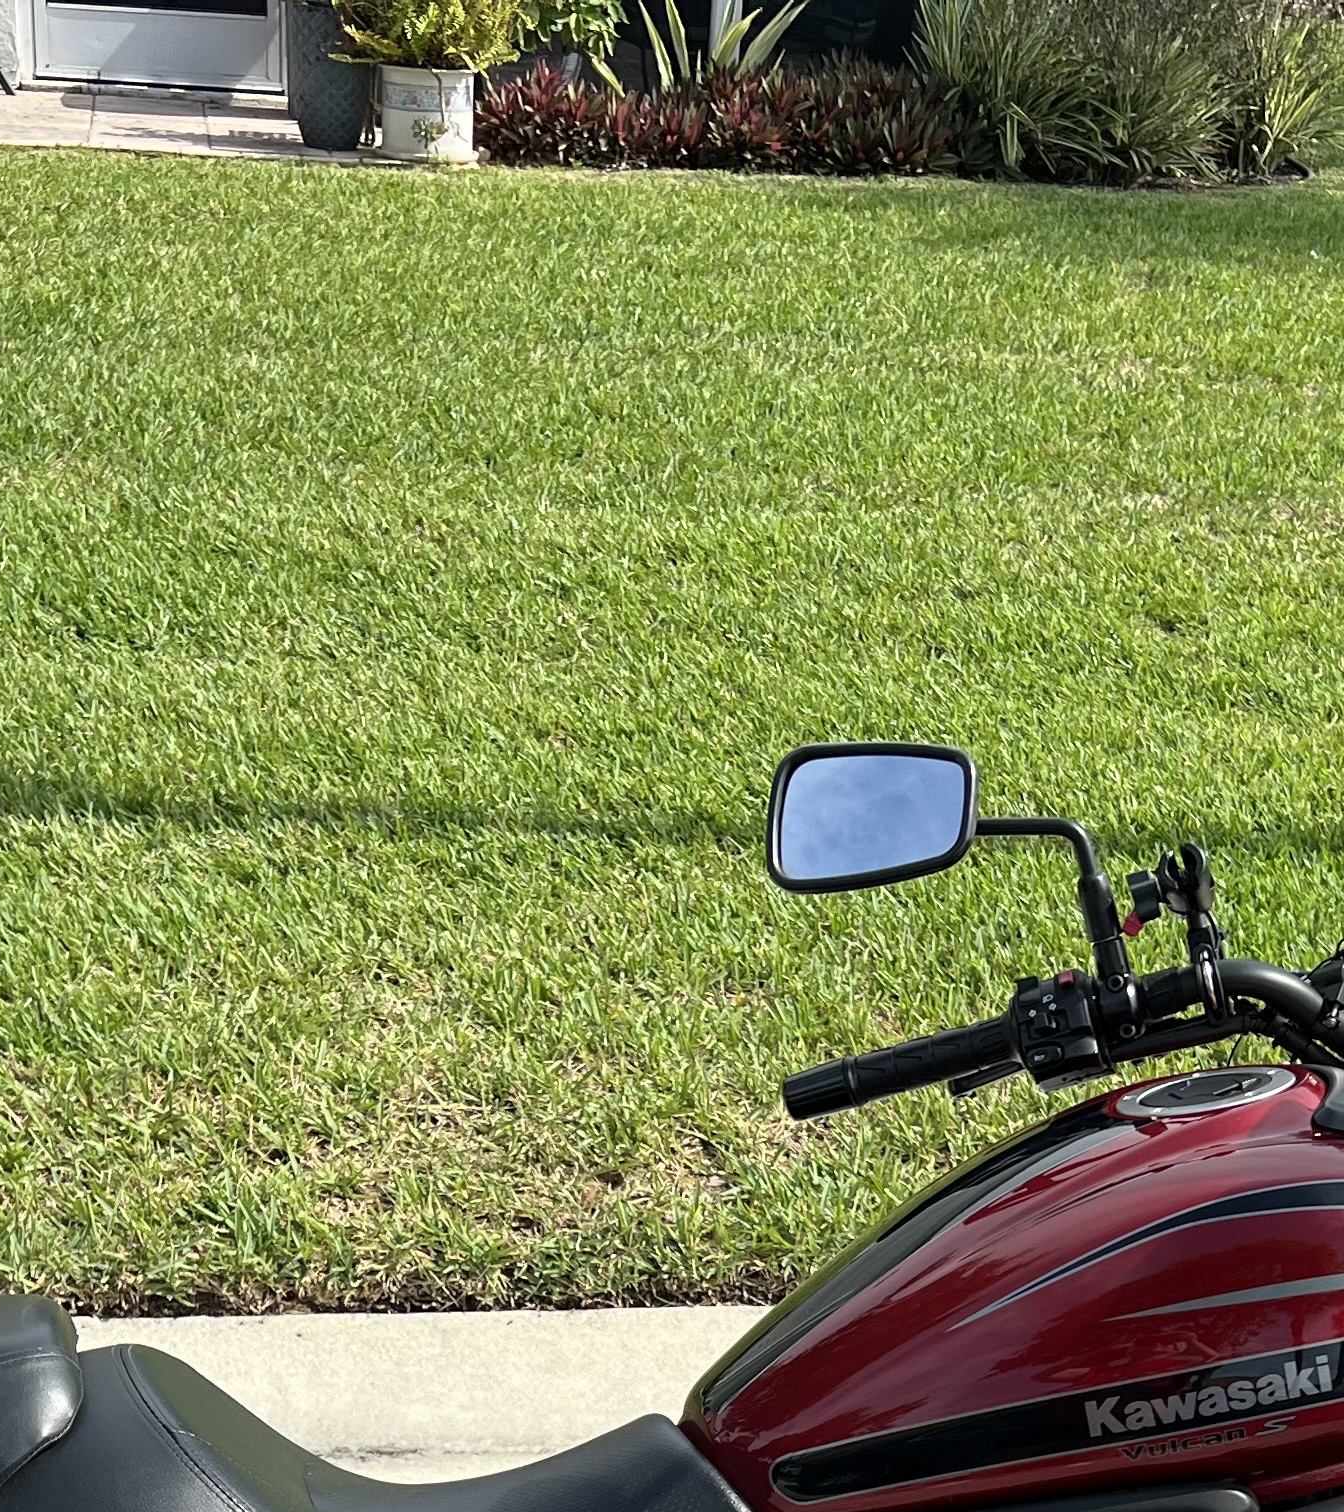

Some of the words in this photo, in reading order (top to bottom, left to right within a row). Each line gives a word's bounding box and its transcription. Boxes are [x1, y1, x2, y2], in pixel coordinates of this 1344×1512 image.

[1084, 1354, 1333, 1438] Kawasaki
[1121, 1426, 1248, 1463] Vulcan
[1254, 1415, 1297, 1438] S
